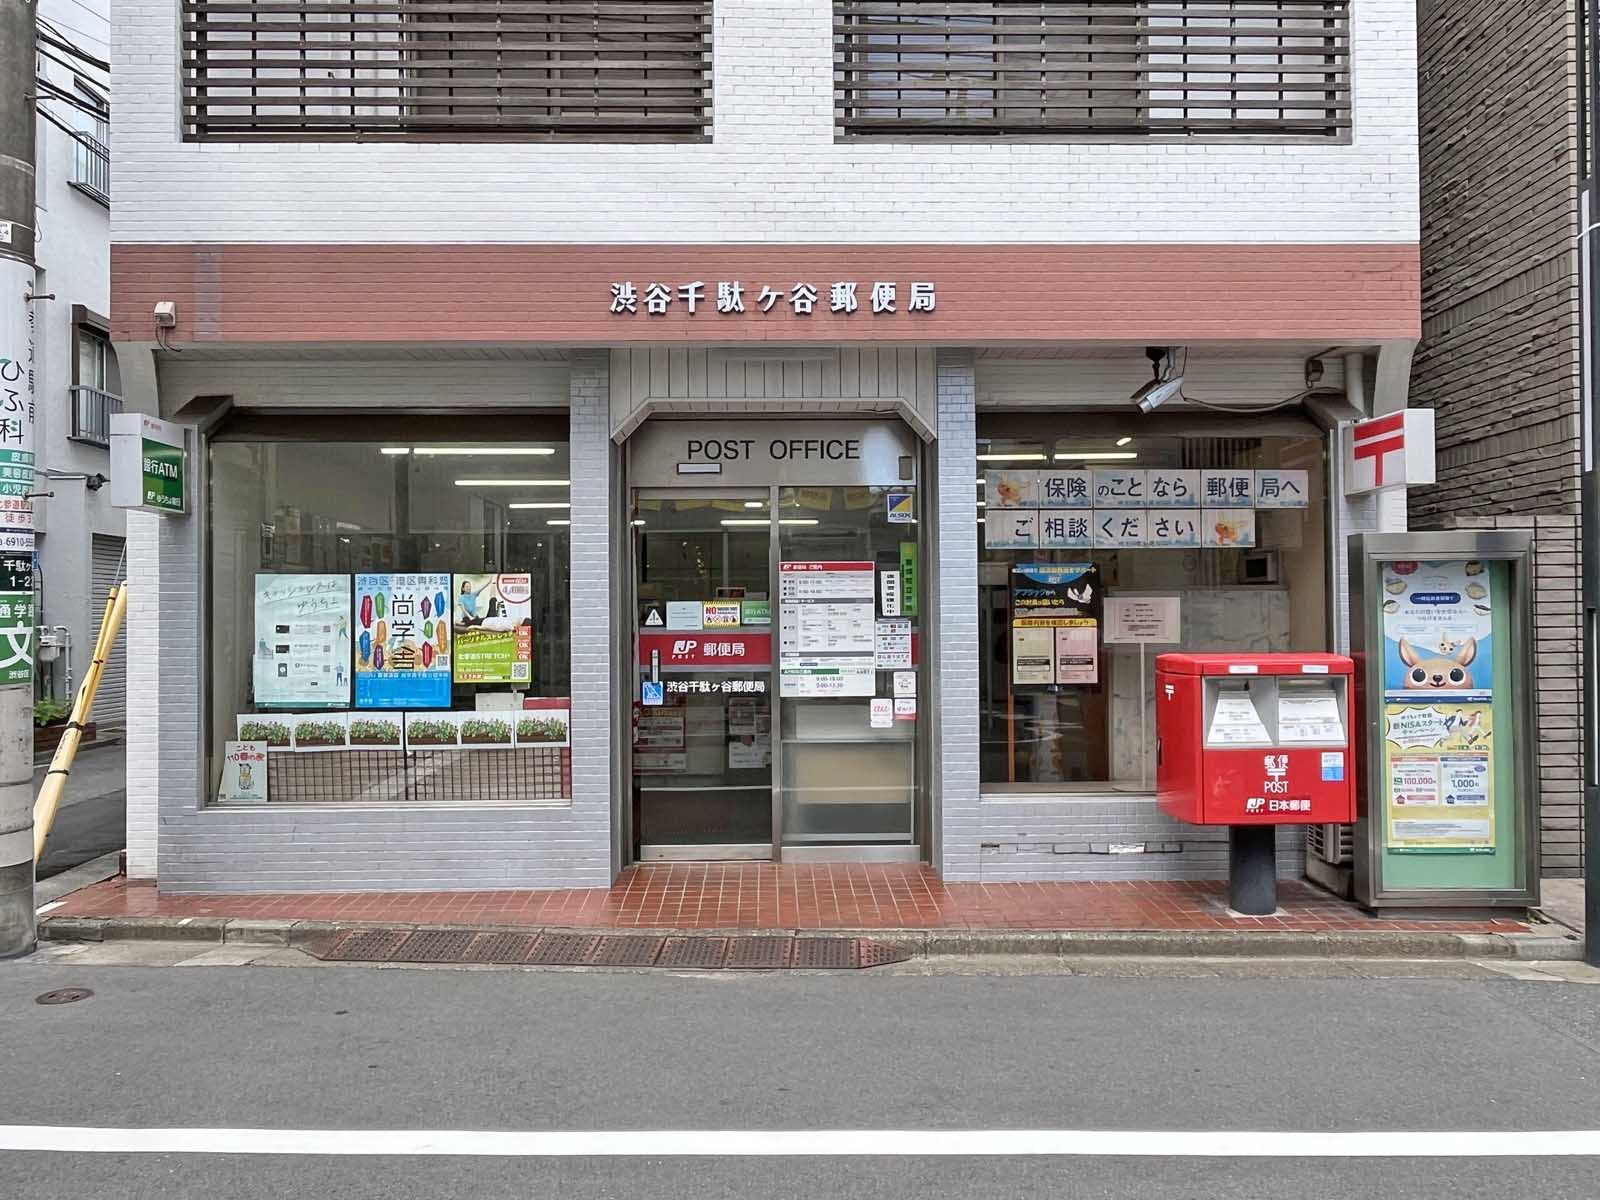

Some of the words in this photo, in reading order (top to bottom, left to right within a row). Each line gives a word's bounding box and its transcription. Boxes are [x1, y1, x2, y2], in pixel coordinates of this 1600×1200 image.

[687, 440, 755, 460] POST
[769, 440, 860, 460] OFFICE
[705, 606, 716, 615] NO
[391, 594, 416, 670] 尚学舎
[703, 643, 745, 656] 郵便局
[1264, 754, 1289, 769] 郵便
[1264, 780, 1289, 793] POST
[1269, 799, 1311, 811] 日本郵便
